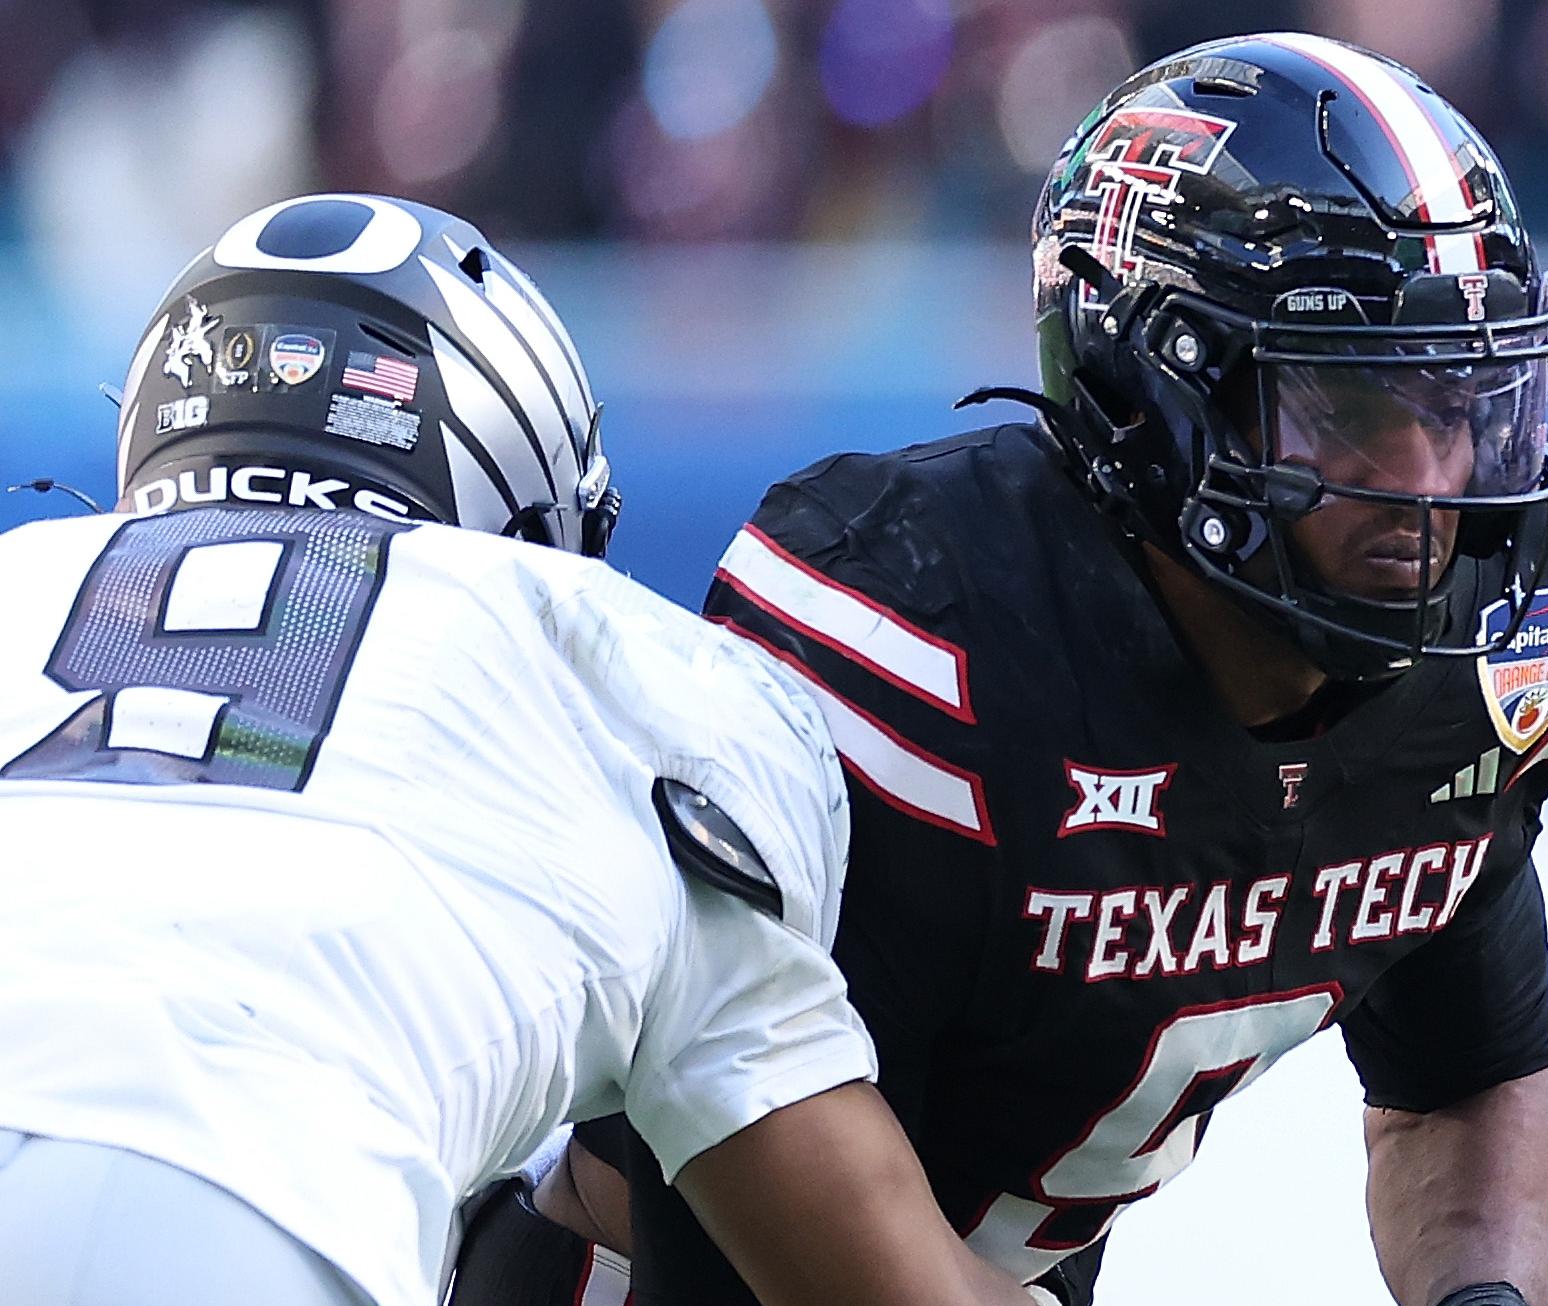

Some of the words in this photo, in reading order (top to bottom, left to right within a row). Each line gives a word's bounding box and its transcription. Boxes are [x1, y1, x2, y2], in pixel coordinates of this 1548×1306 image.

[1328, 293, 1347, 311] UP
[1493, 662, 1545, 699] ORANGE
[1024, 876, 1292, 982] TEXAS
[1311, 833, 1493, 954] TECH
